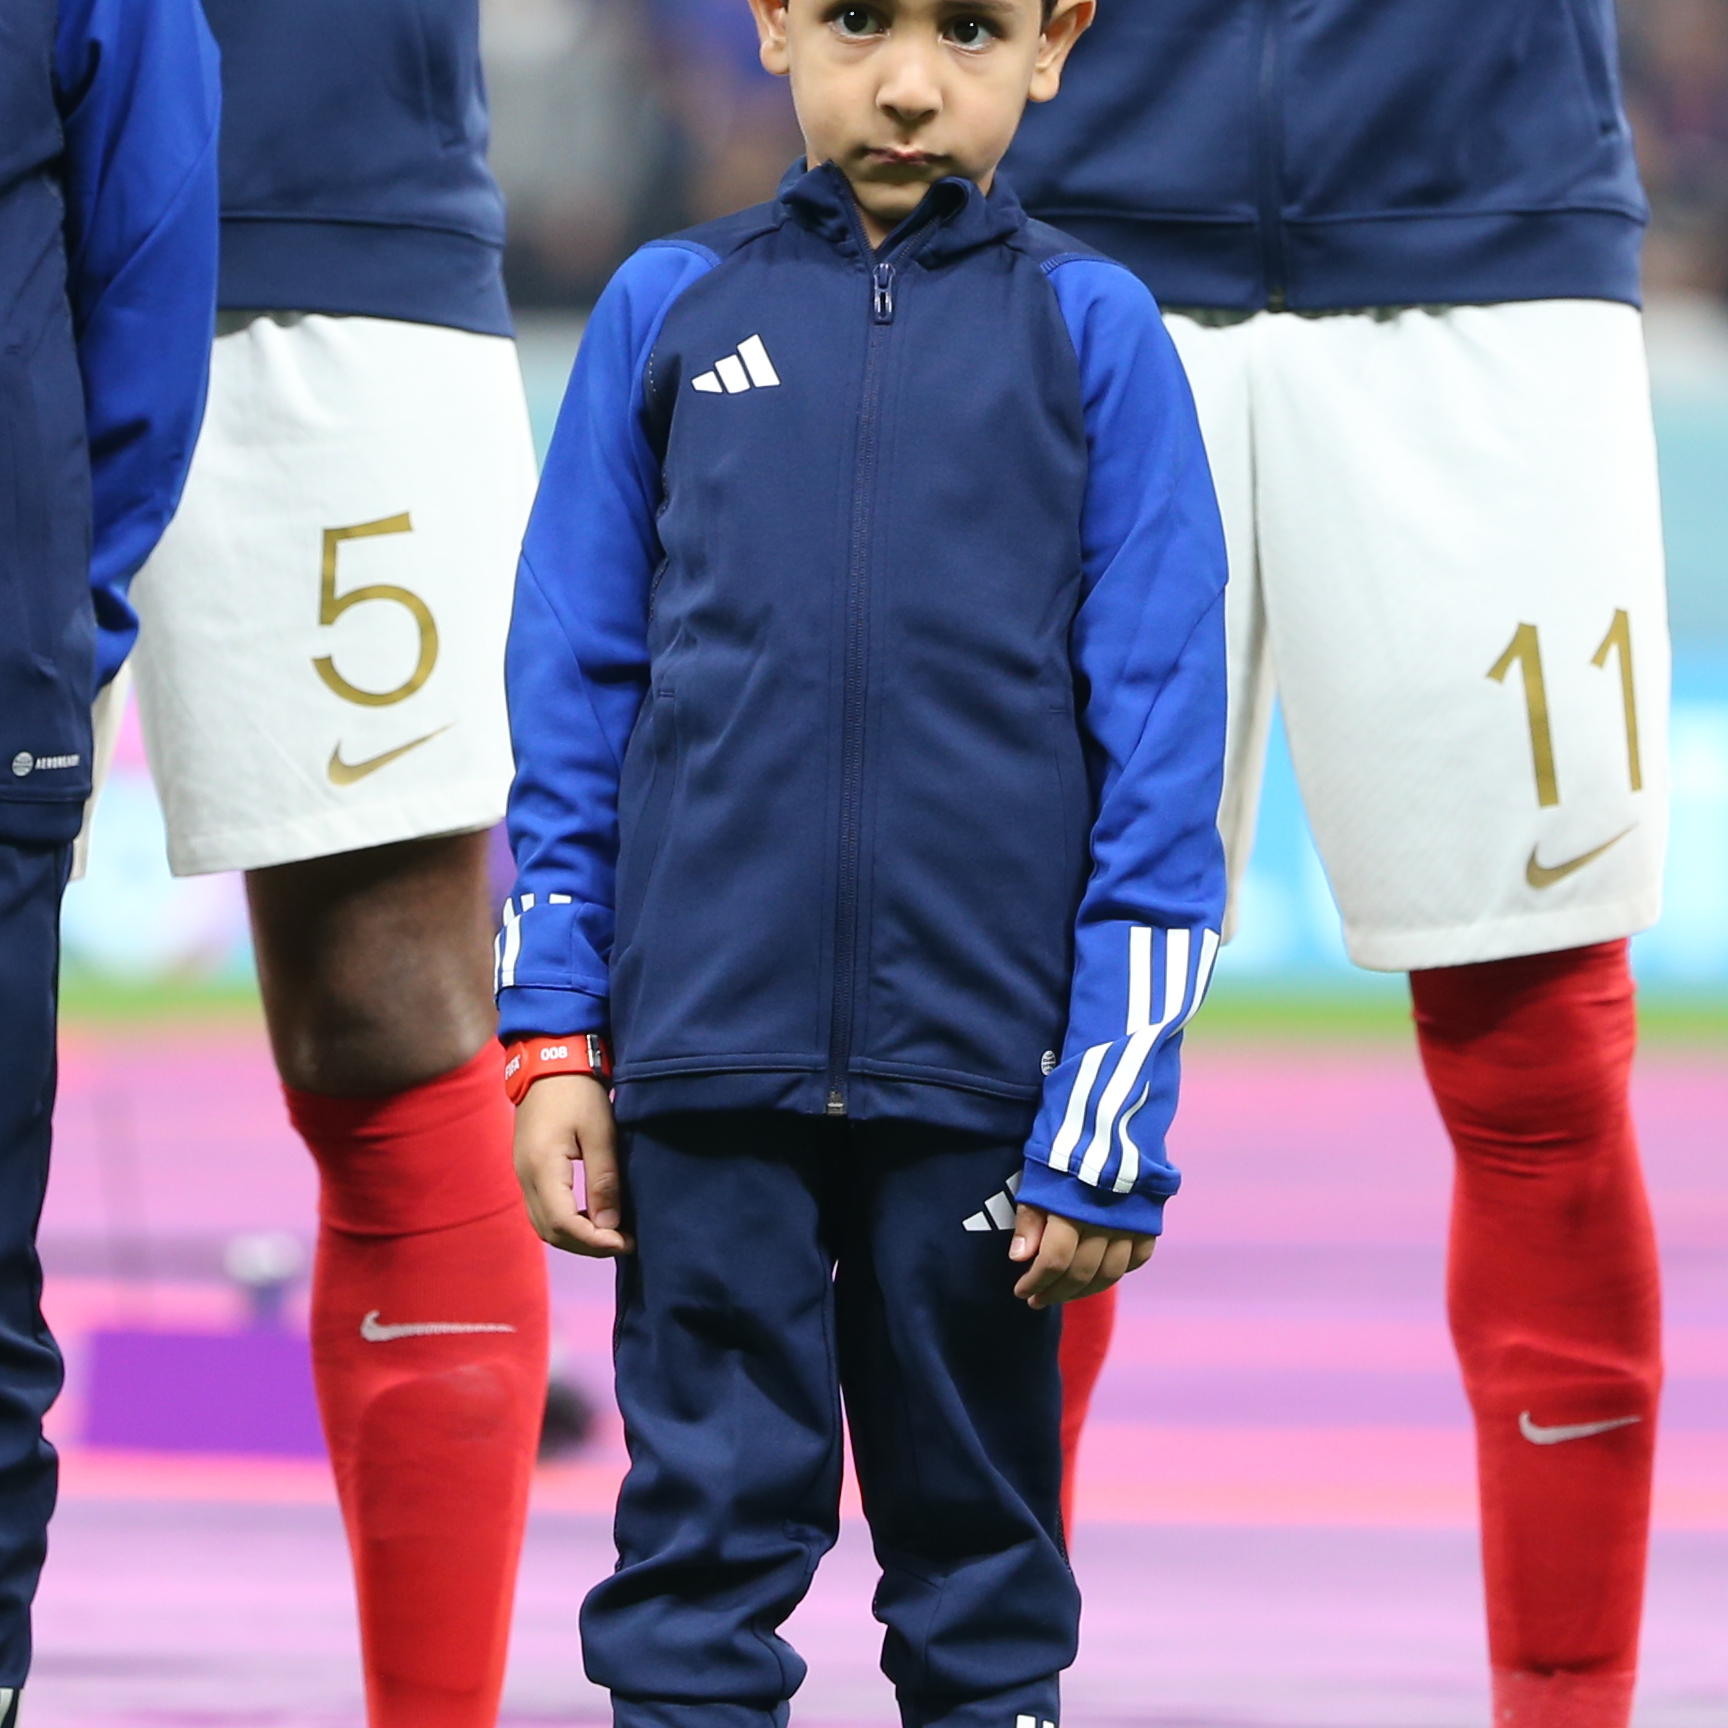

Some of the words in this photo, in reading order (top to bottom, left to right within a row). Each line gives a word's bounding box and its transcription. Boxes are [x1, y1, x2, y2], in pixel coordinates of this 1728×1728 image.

[311, 511, 439, 707] 5
[1484, 608, 1643, 809] 11
[505, 1054, 521, 1081] FIFA
[540, 1046, 569, 1061] 008
